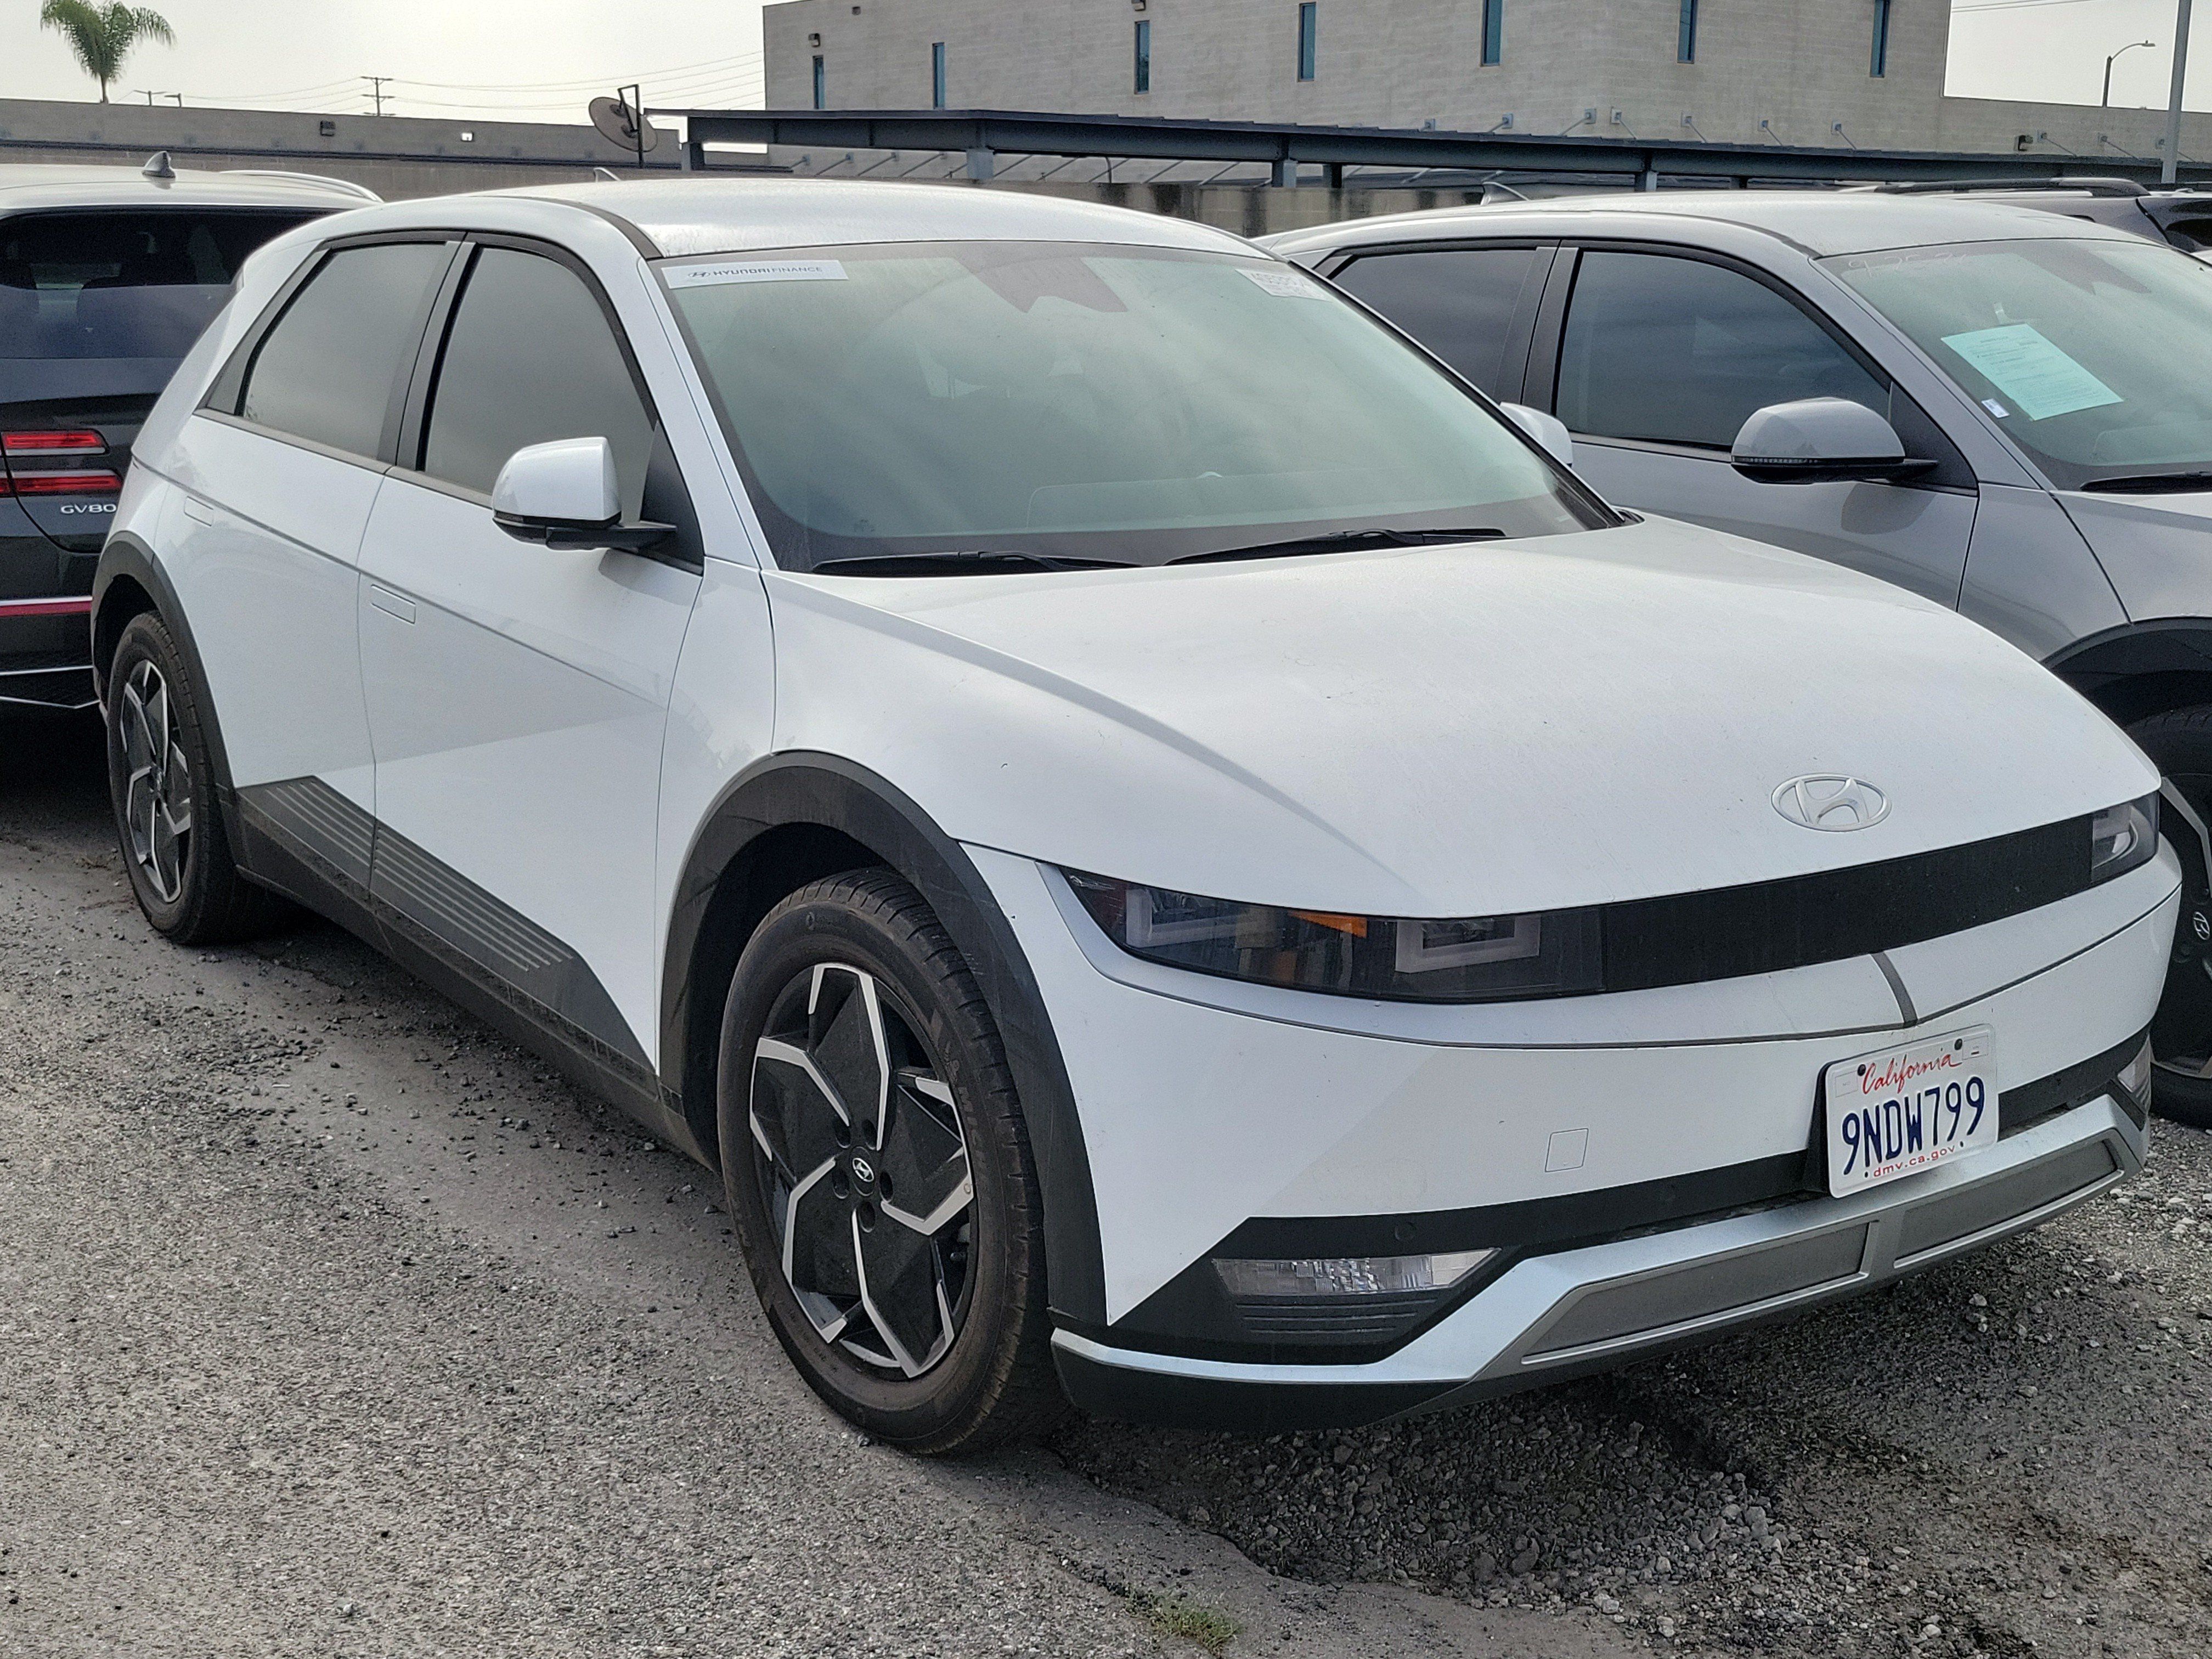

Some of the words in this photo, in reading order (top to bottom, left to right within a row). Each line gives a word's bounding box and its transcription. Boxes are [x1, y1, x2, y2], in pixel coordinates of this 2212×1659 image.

[61, 504, 117, 514] GV80
[1863, 1047, 1962, 1095] California
[1842, 1076, 1985, 1175] 9NDW799
[1873, 1144, 1956, 1178] dmv.ca.gov
